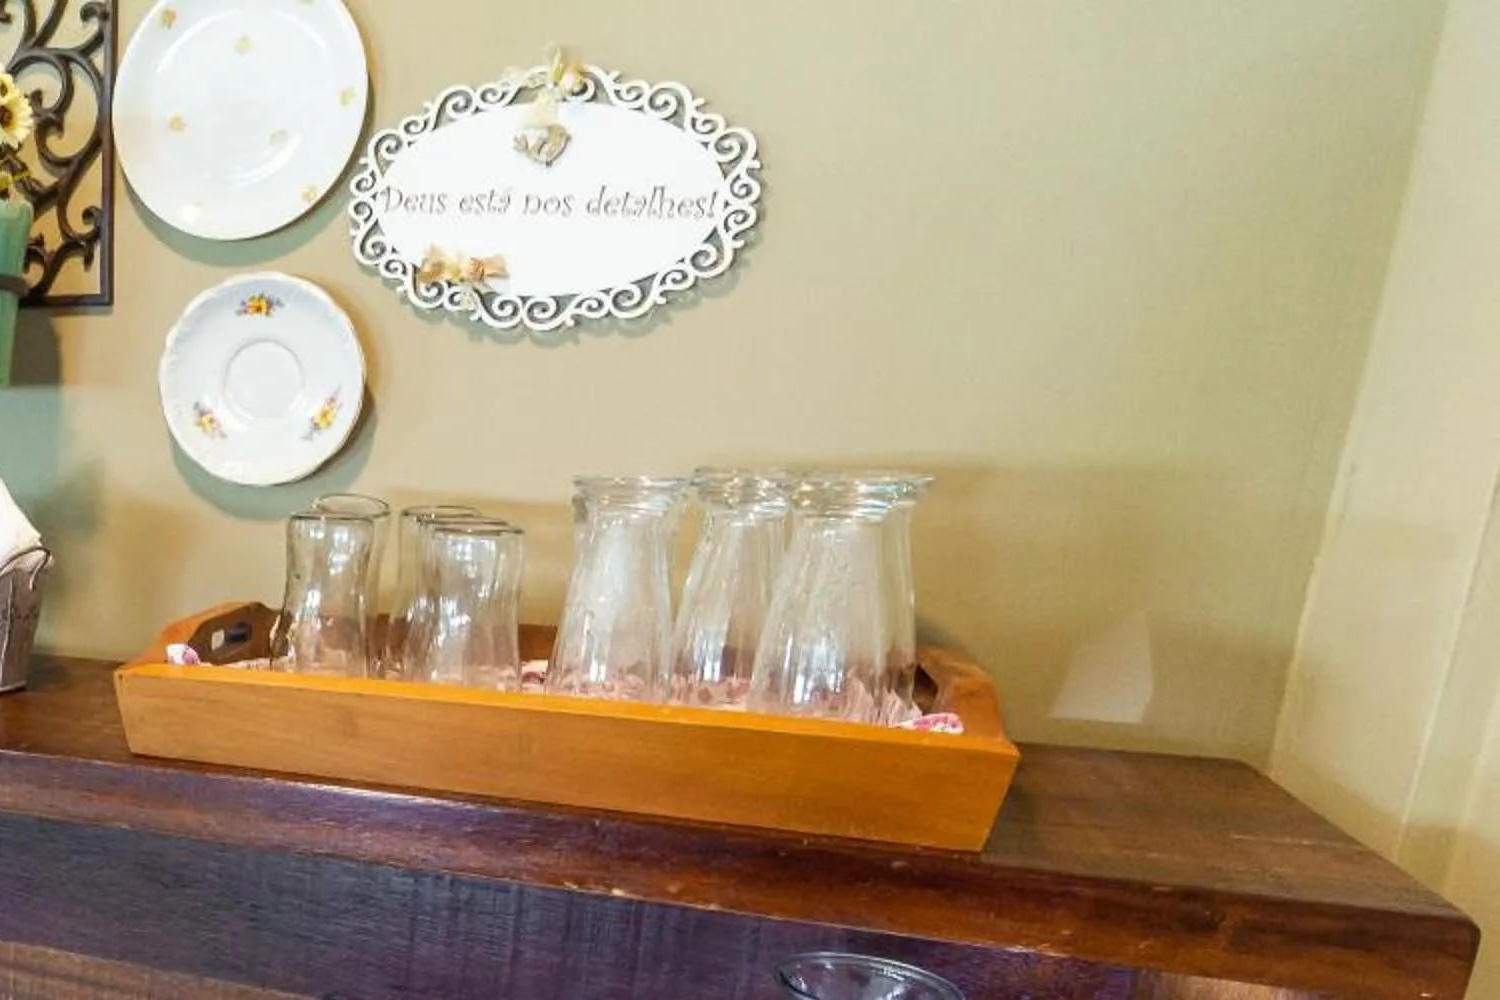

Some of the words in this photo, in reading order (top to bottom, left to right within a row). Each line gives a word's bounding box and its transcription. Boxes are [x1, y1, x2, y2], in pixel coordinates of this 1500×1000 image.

[380, 185, 448, 215] Deus
[523, 193, 574, 217] nos
[587, 184, 717, 219] detalhes!
